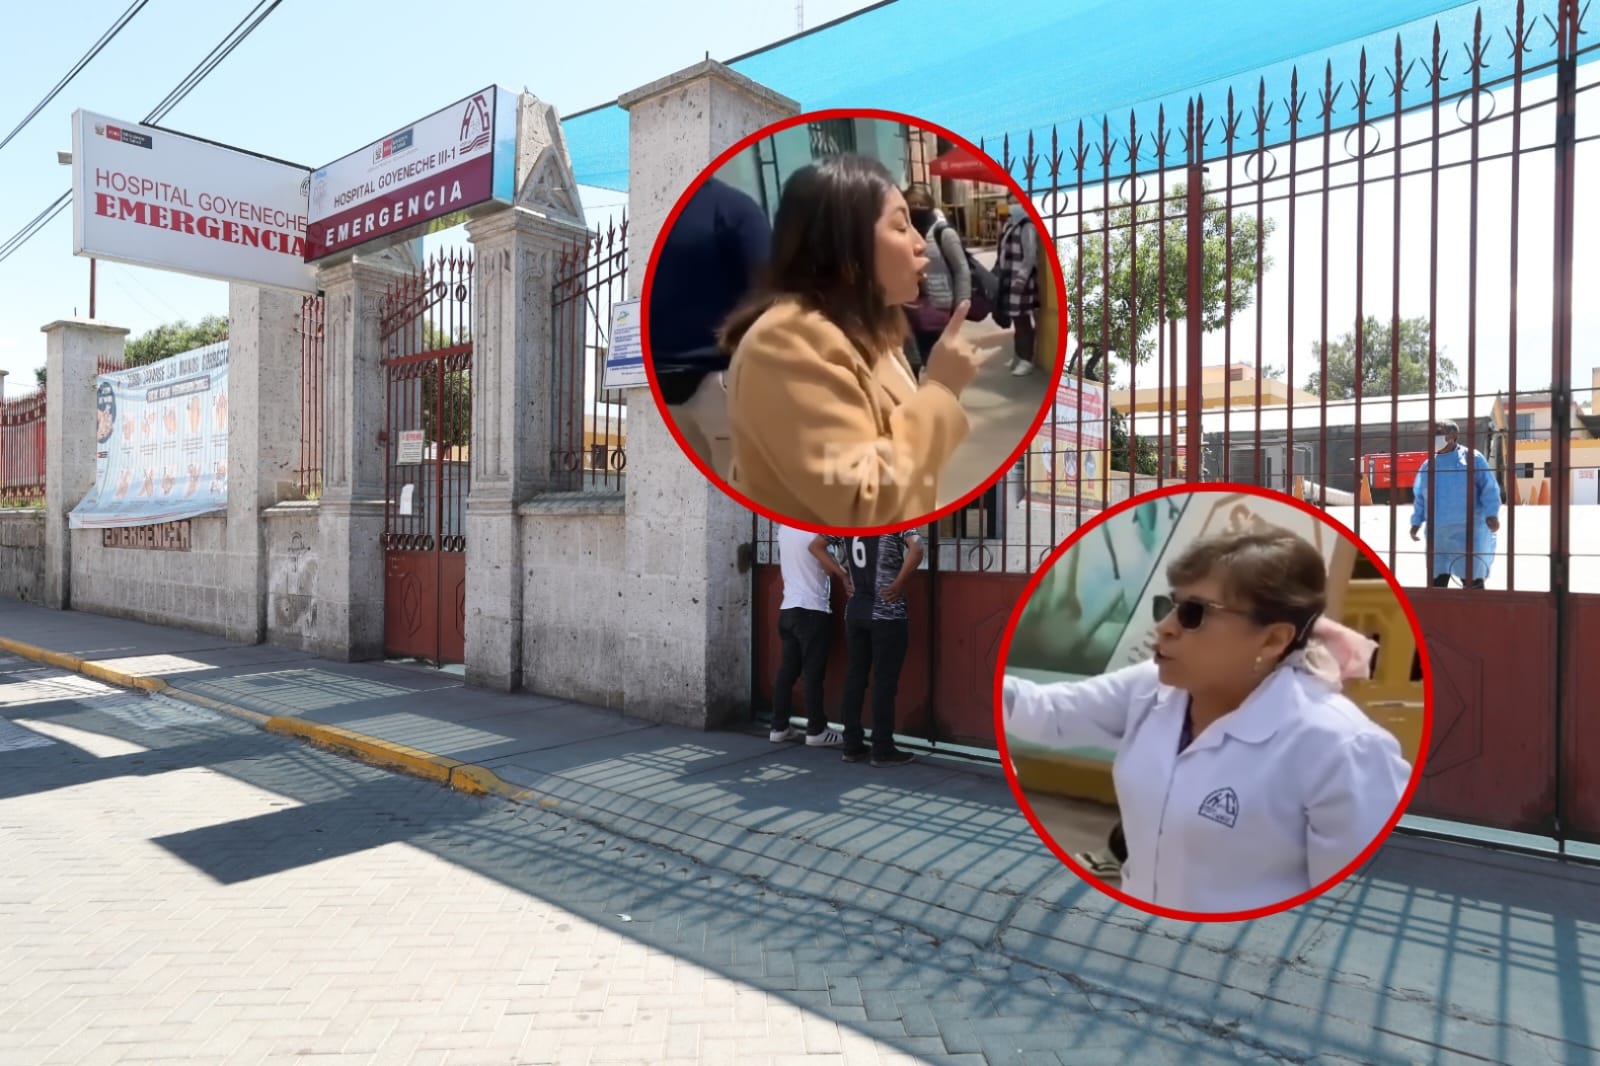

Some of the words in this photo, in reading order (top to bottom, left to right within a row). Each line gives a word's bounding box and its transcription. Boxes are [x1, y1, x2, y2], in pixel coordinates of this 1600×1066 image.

[96, 168, 194, 208] HOSPITAL
[198, 192, 307, 233] GOYENECHE
[334, 180, 376, 208] HOSPITAL
[378, 154, 436, 190] GOYENECHE
[438, 146, 456, 166] III-1
[95, 192, 307, 258] EMERGENCIA
[325, 180, 462, 248] EMERGENCIA
[104, 520, 190, 549] EMERGENCIA
[852, 535, 867, 569] 6
